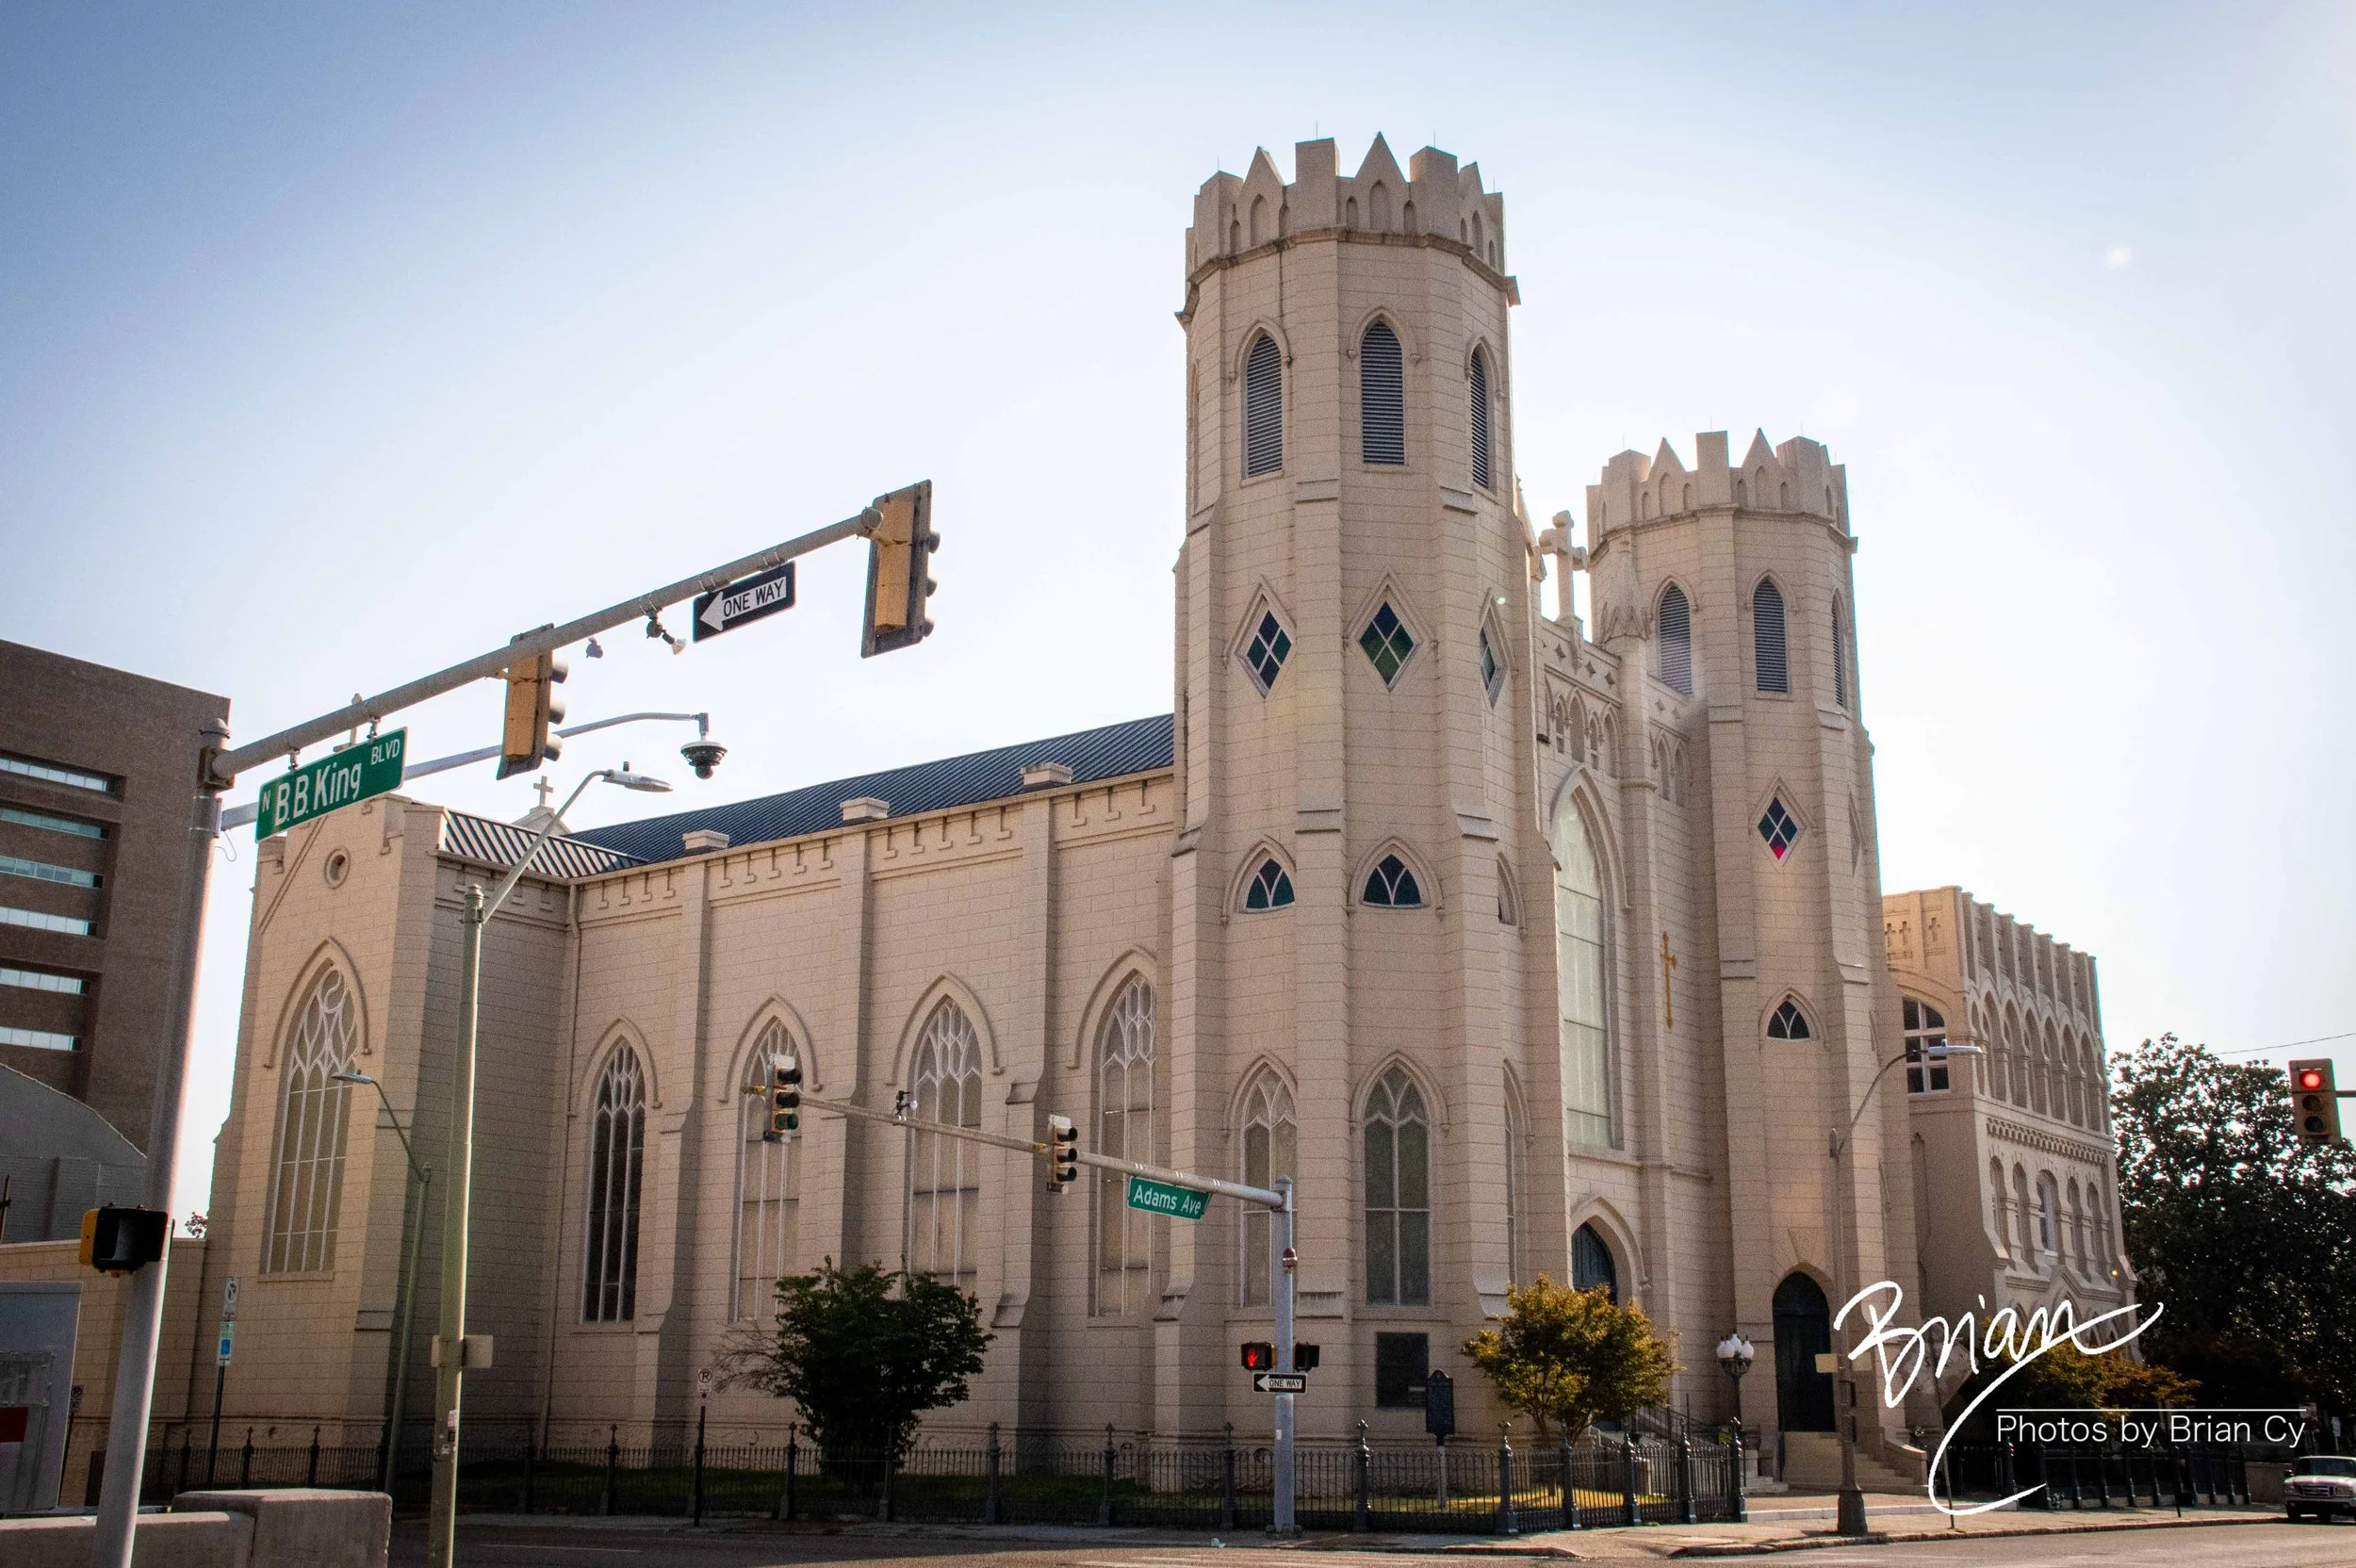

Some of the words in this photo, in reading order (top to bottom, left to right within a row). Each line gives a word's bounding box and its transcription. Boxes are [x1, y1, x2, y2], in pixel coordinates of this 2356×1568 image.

[723, 592, 751, 617] ONE
[755, 579, 784, 606] WAY
[261, 790, 271, 813] N
[313, 761, 362, 811] King
[370, 739, 401, 765] BLVD
[1133, 1184, 1178, 1211] Adams
[1180, 1195, 1202, 1215] Ave
[1268, 1379, 1284, 1387] ONE
